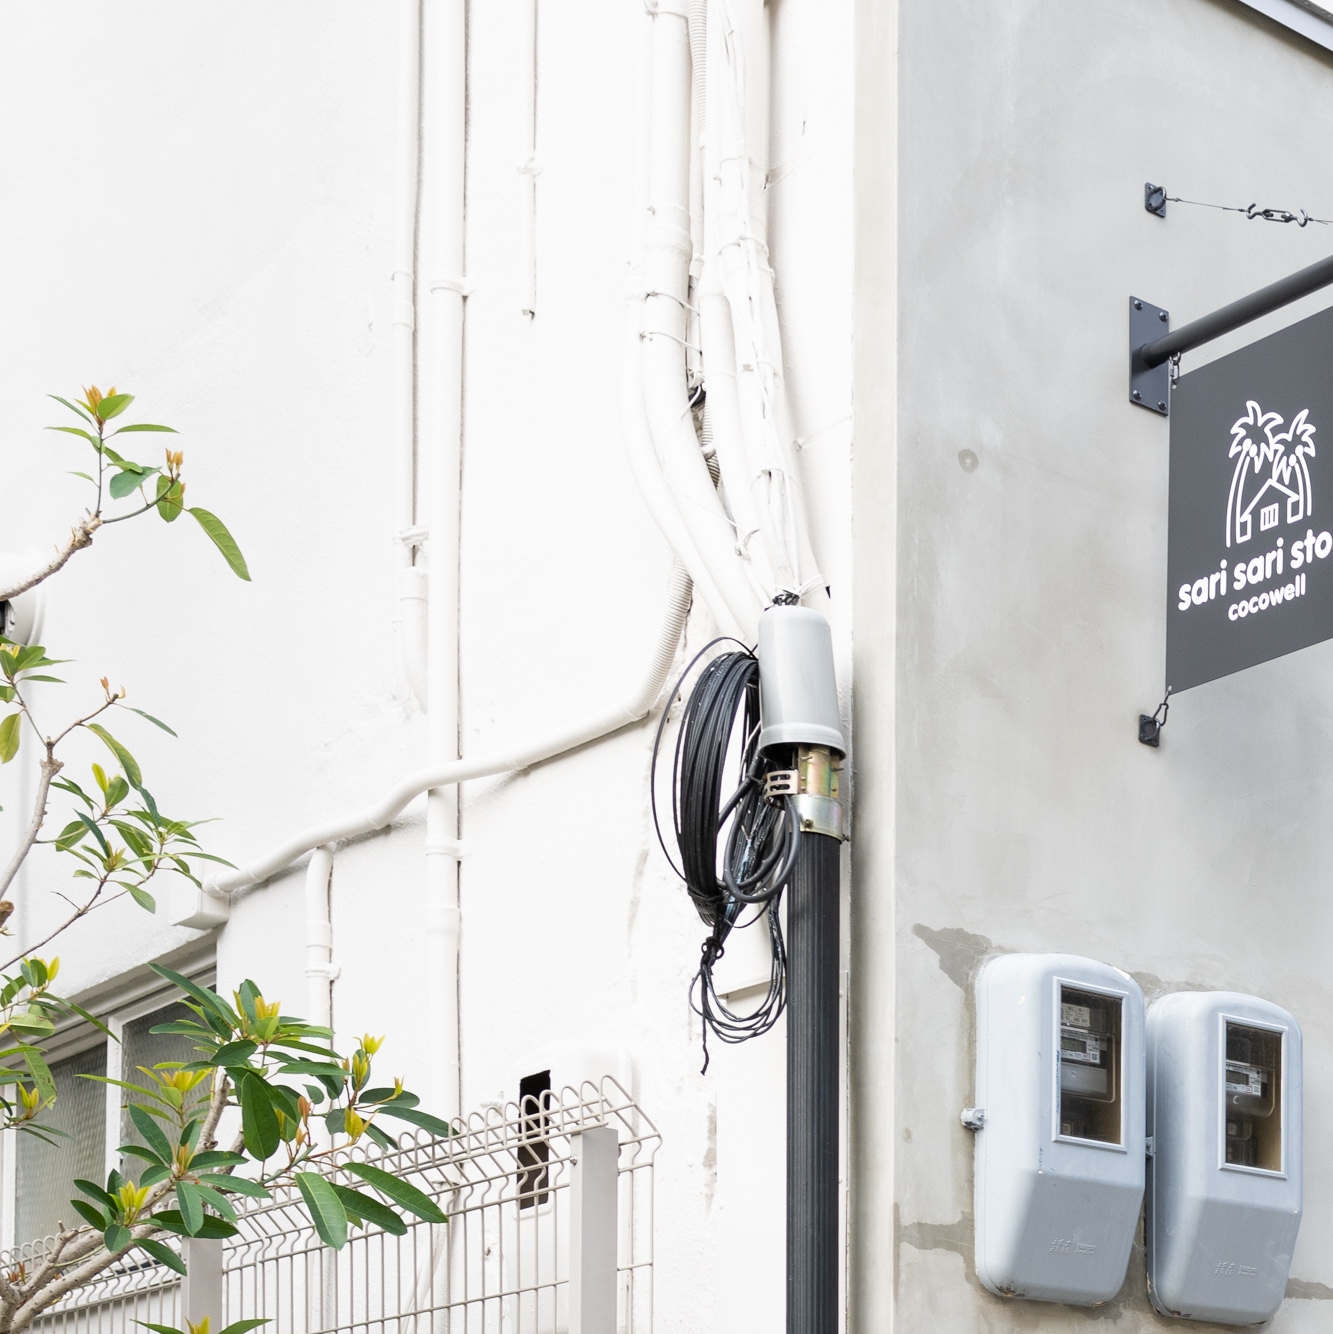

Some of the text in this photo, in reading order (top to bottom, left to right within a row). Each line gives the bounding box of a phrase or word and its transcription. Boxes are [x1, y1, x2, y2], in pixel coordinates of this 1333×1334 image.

[1178, 559, 1228, 611] sari
[1233, 537, 1284, 590] sari
[1228, 573, 1306, 621] cocowell
